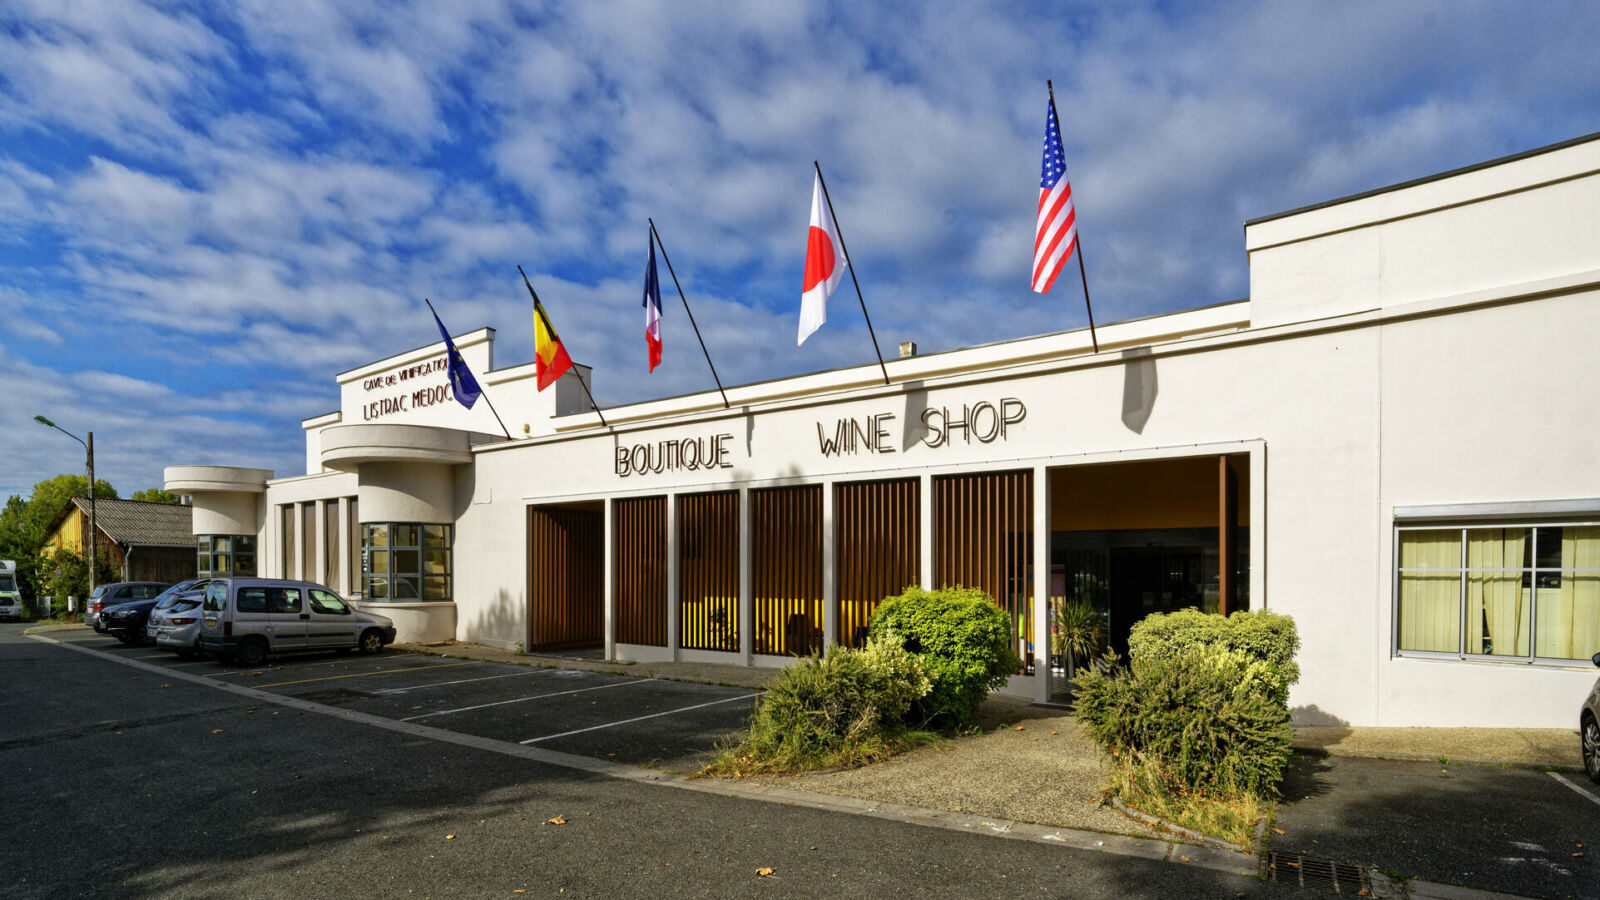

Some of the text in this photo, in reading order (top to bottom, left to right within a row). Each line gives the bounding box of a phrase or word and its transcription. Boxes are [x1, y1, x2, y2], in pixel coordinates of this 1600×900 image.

[363, 382, 454, 421] LISTRAC MEDOC
[364, 376, 384, 392] CAVE
[385, 374, 397, 387] DE
[614, 397, 1027, 478] BOUTIQUE WINE SHOP
